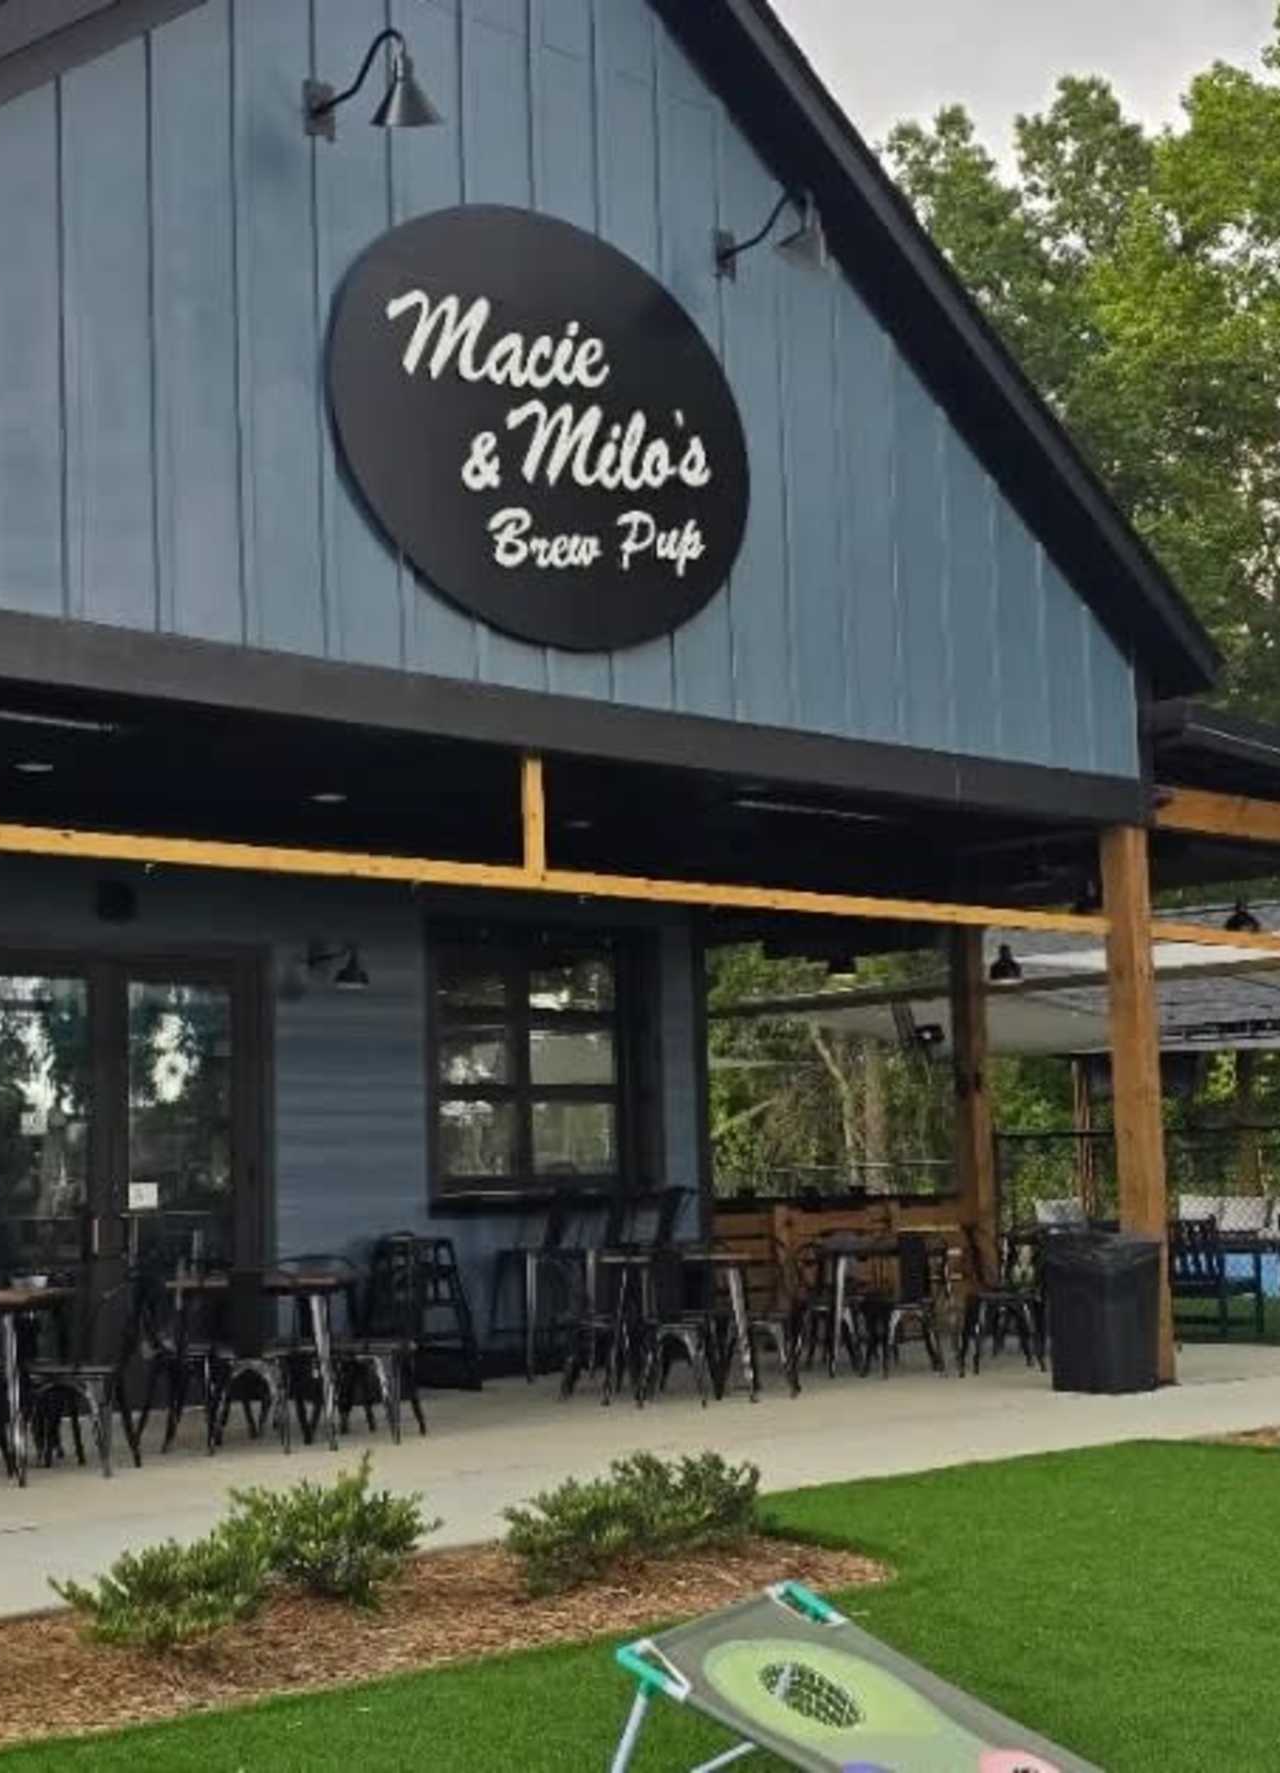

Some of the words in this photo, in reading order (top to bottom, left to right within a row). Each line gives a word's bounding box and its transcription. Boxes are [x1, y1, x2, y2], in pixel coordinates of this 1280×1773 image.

[385, 288, 611, 389] Macie
[461, 430, 501, 491] &
[505, 398, 712, 491] Milo's
[486, 506, 603, 569] Brew
[616, 509, 706, 578] Pup
